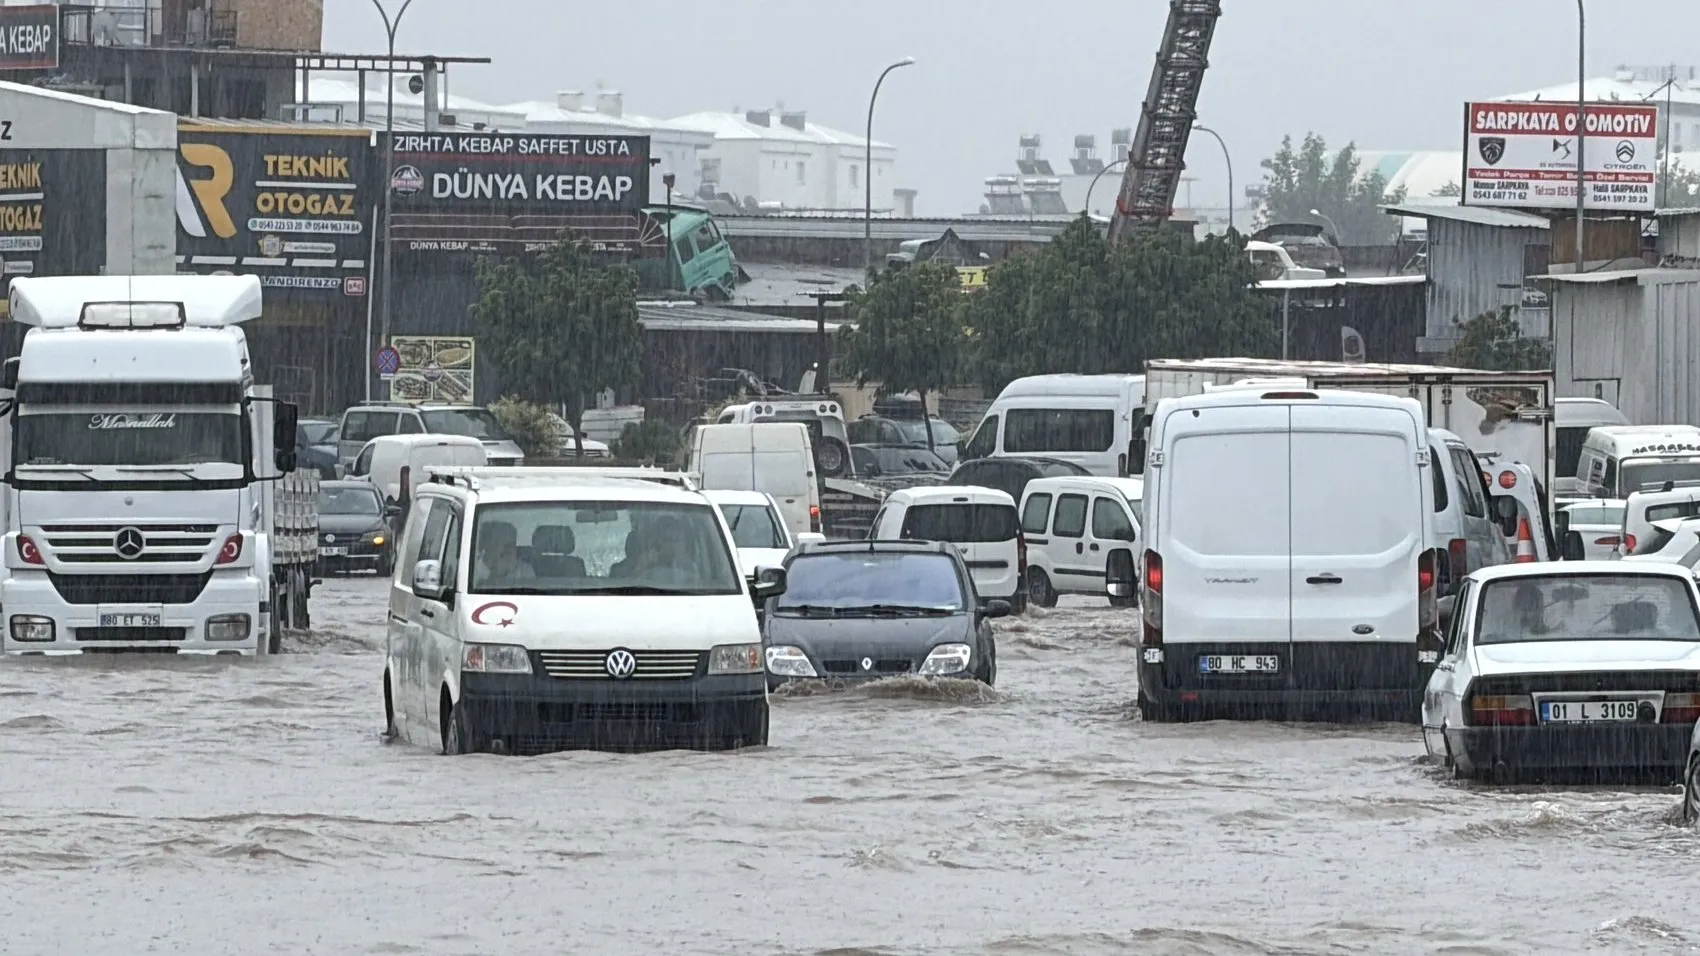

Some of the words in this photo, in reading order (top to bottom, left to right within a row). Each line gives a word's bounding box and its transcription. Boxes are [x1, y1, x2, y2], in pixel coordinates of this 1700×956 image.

[10, 24, 51, 54] KEBAP
[1476, 110, 1560, 131] SARPKAYA
[394, 135, 454, 152] ZIRHTA
[459, 136, 514, 153] KEBAP
[518, 138, 580, 155] SAFFET
[585, 138, 630, 156] USTA
[264, 149, 350, 178] TEKNİK
[433, 167, 528, 199] DÜNYA
[536, 174, 633, 201] KEBAP
[1497, 181, 1530, 190] SARPKAYA
[1610, 184, 1648, 194] SARPKAYA
[256, 192, 355, 215] OTOGAZ
[106, 614, 118, 626] 80
[1208, 656, 1222, 669] 80
[1231, 656, 1246, 669] HC
[1256, 656, 1277, 669] 943
[1552, 703, 1568, 720] 01
[1581, 703, 1590, 719] L
[1600, 702, 1635, 719] 3109
